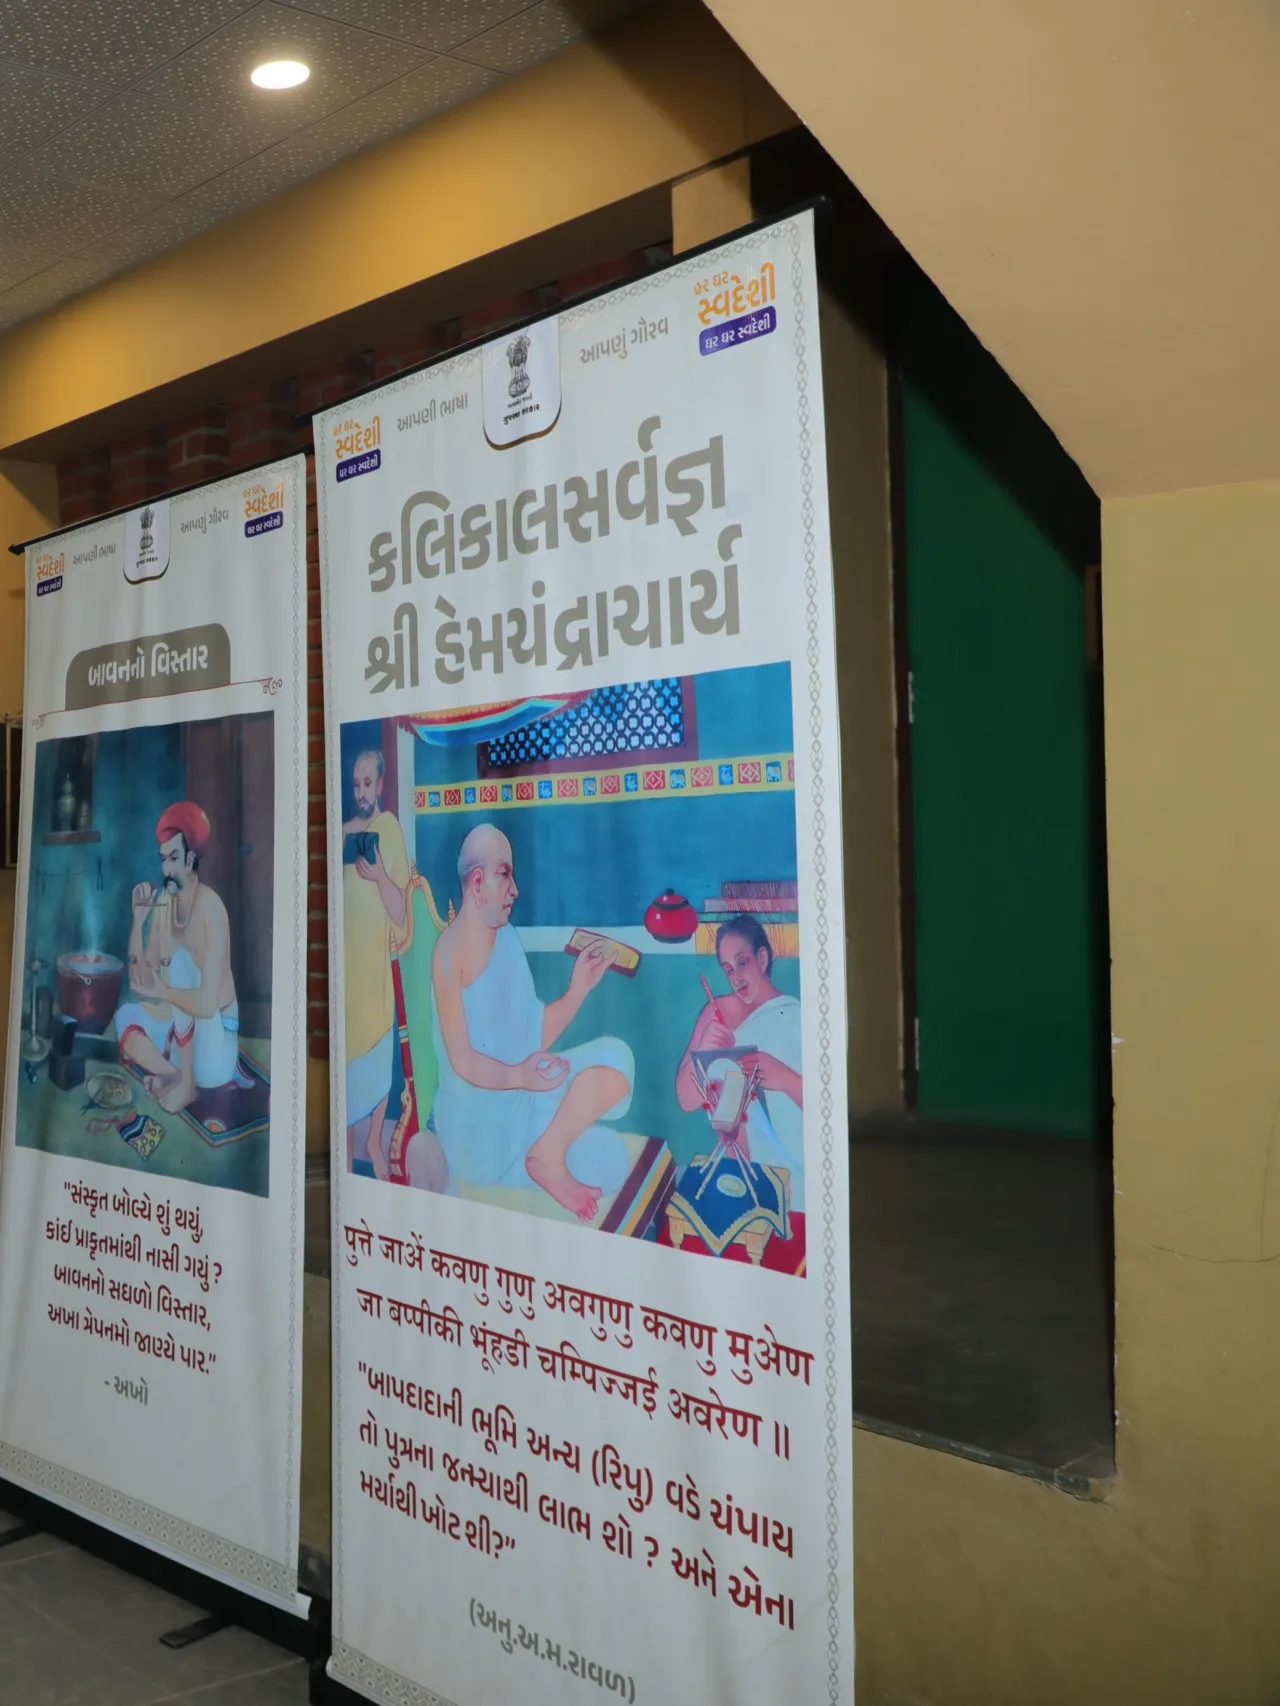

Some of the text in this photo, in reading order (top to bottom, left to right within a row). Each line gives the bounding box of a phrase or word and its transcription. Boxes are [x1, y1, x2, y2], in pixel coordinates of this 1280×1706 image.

[698, 262, 775, 325] સ્વદેશી
[713, 271, 729, 287] ઘર
[580, 317, 669, 364] આપણું ગૌરવ
[705, 313, 771, 349] ઘર ઘર સ્વદેશી
[336, 415, 381, 460] સ્વદેશી
[397, 392, 468, 432] આપણી ભાષા
[358, 453, 379, 472] સ્વદેશી
[181, 511, 207, 534] આપણું
[244, 483, 284, 518] સ્વદેશી
[369, 415, 727, 593] કલિકાલસર્વજ્ઞ
[364, 524, 743, 695] શ્રી હેમચંદ્રાચાર્ય
[88, 642, 209, 686] બાવનનો વિસ્તાર
[64, 1180, 204, 1244] "સંસ્કૃત બોલ્યે શું થયું,
[45, 1217, 72, 1244] કાંઈ
[75, 1227, 142, 1261] પ્રાકૃતમાંથી
[146, 1243, 180, 1273] નાસી
[184, 1254, 210, 1292] ગયું
[54, 1264, 211, 1332] બાવનનો સઘળો વિસ્તાર,
[343, 1218, 373, 1267] पुत्ते
[429, 1248, 490, 1306] कवणु
[495, 1266, 536, 1321] गुणु
[542, 1280, 634, 1350] अवगुणु
[640, 1305, 718, 1377] कवणु
[725, 1324, 815, 1386] मुअेण
[47, 1303, 80, 1331] અખા
[83, 1306, 130, 1347] ત્રેપનમો
[134, 1331, 176, 1362] જાણ્યે
[113, 1376, 148, 1406] અખો
[356, 1287, 383, 1320] जा
[387, 1298, 463, 1348] बप्पीकी
[470, 1321, 531, 1375] भूंहडी
[535, 1340, 660, 1420] चम्पिज्जई
[667, 1387, 763, 1447] अवरेण
[358, 1361, 795, 1559] "બાપદાદાની ભૂમિ અન્ય (રિપુ) વડે ચંપાય
[359, 1470, 418, 1520] મર્યાથી
[420, 1493, 461, 1540] ખોટ
[359, 1409, 795, 1631] તો પુત્રના જન્મ્યાથી લાભ શો ? અને એના
